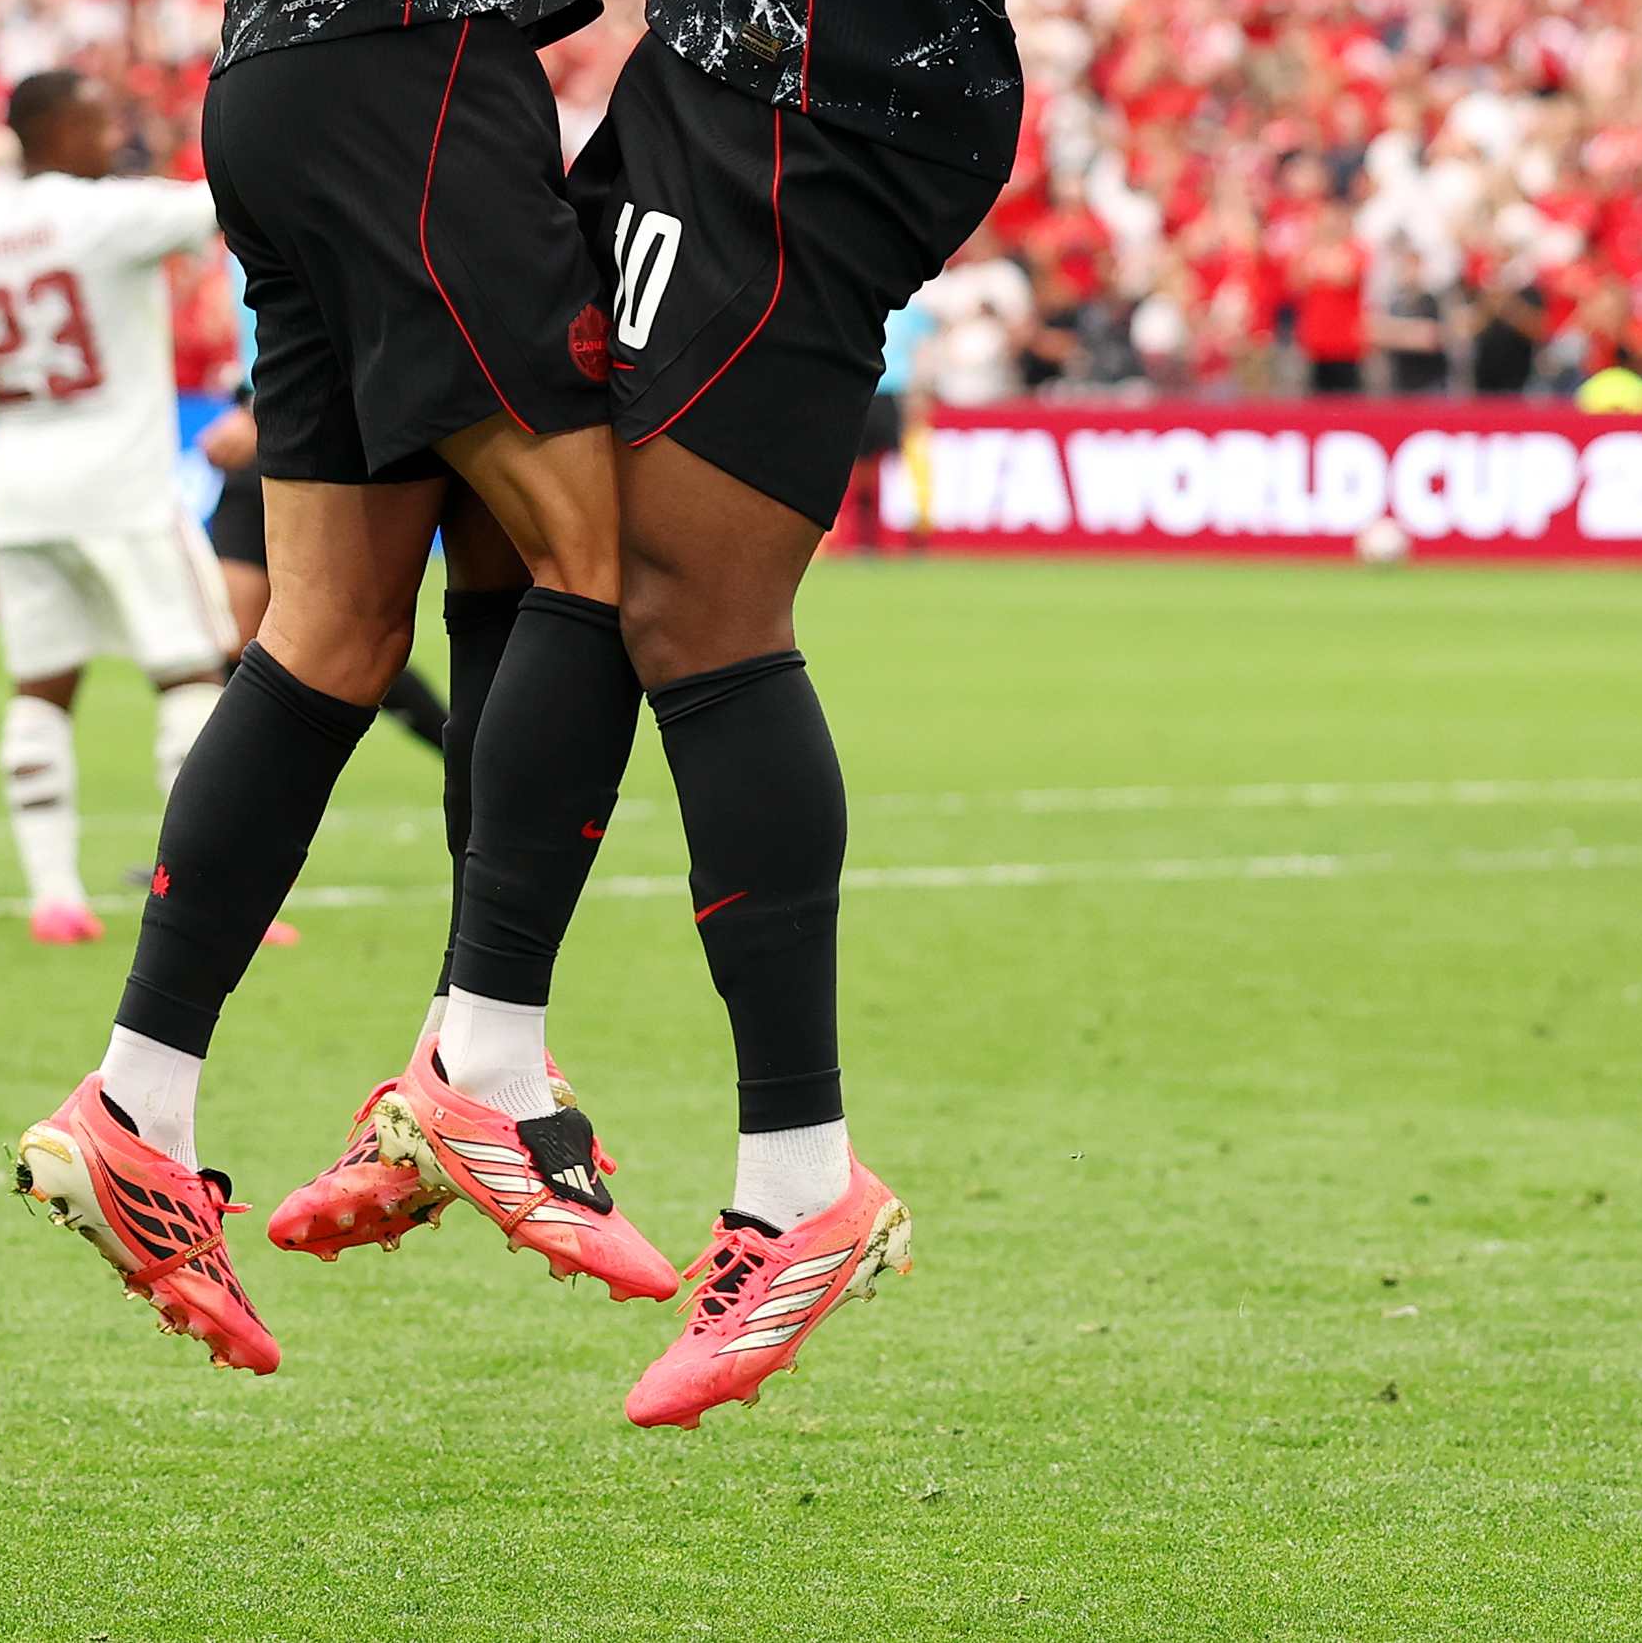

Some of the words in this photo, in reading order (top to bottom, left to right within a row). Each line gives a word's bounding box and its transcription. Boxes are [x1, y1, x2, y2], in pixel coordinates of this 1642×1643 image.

[613, 201, 683, 350] 10
[1064, 427, 1388, 536] WORLD
[1391, 429, 1579, 539] CUP
